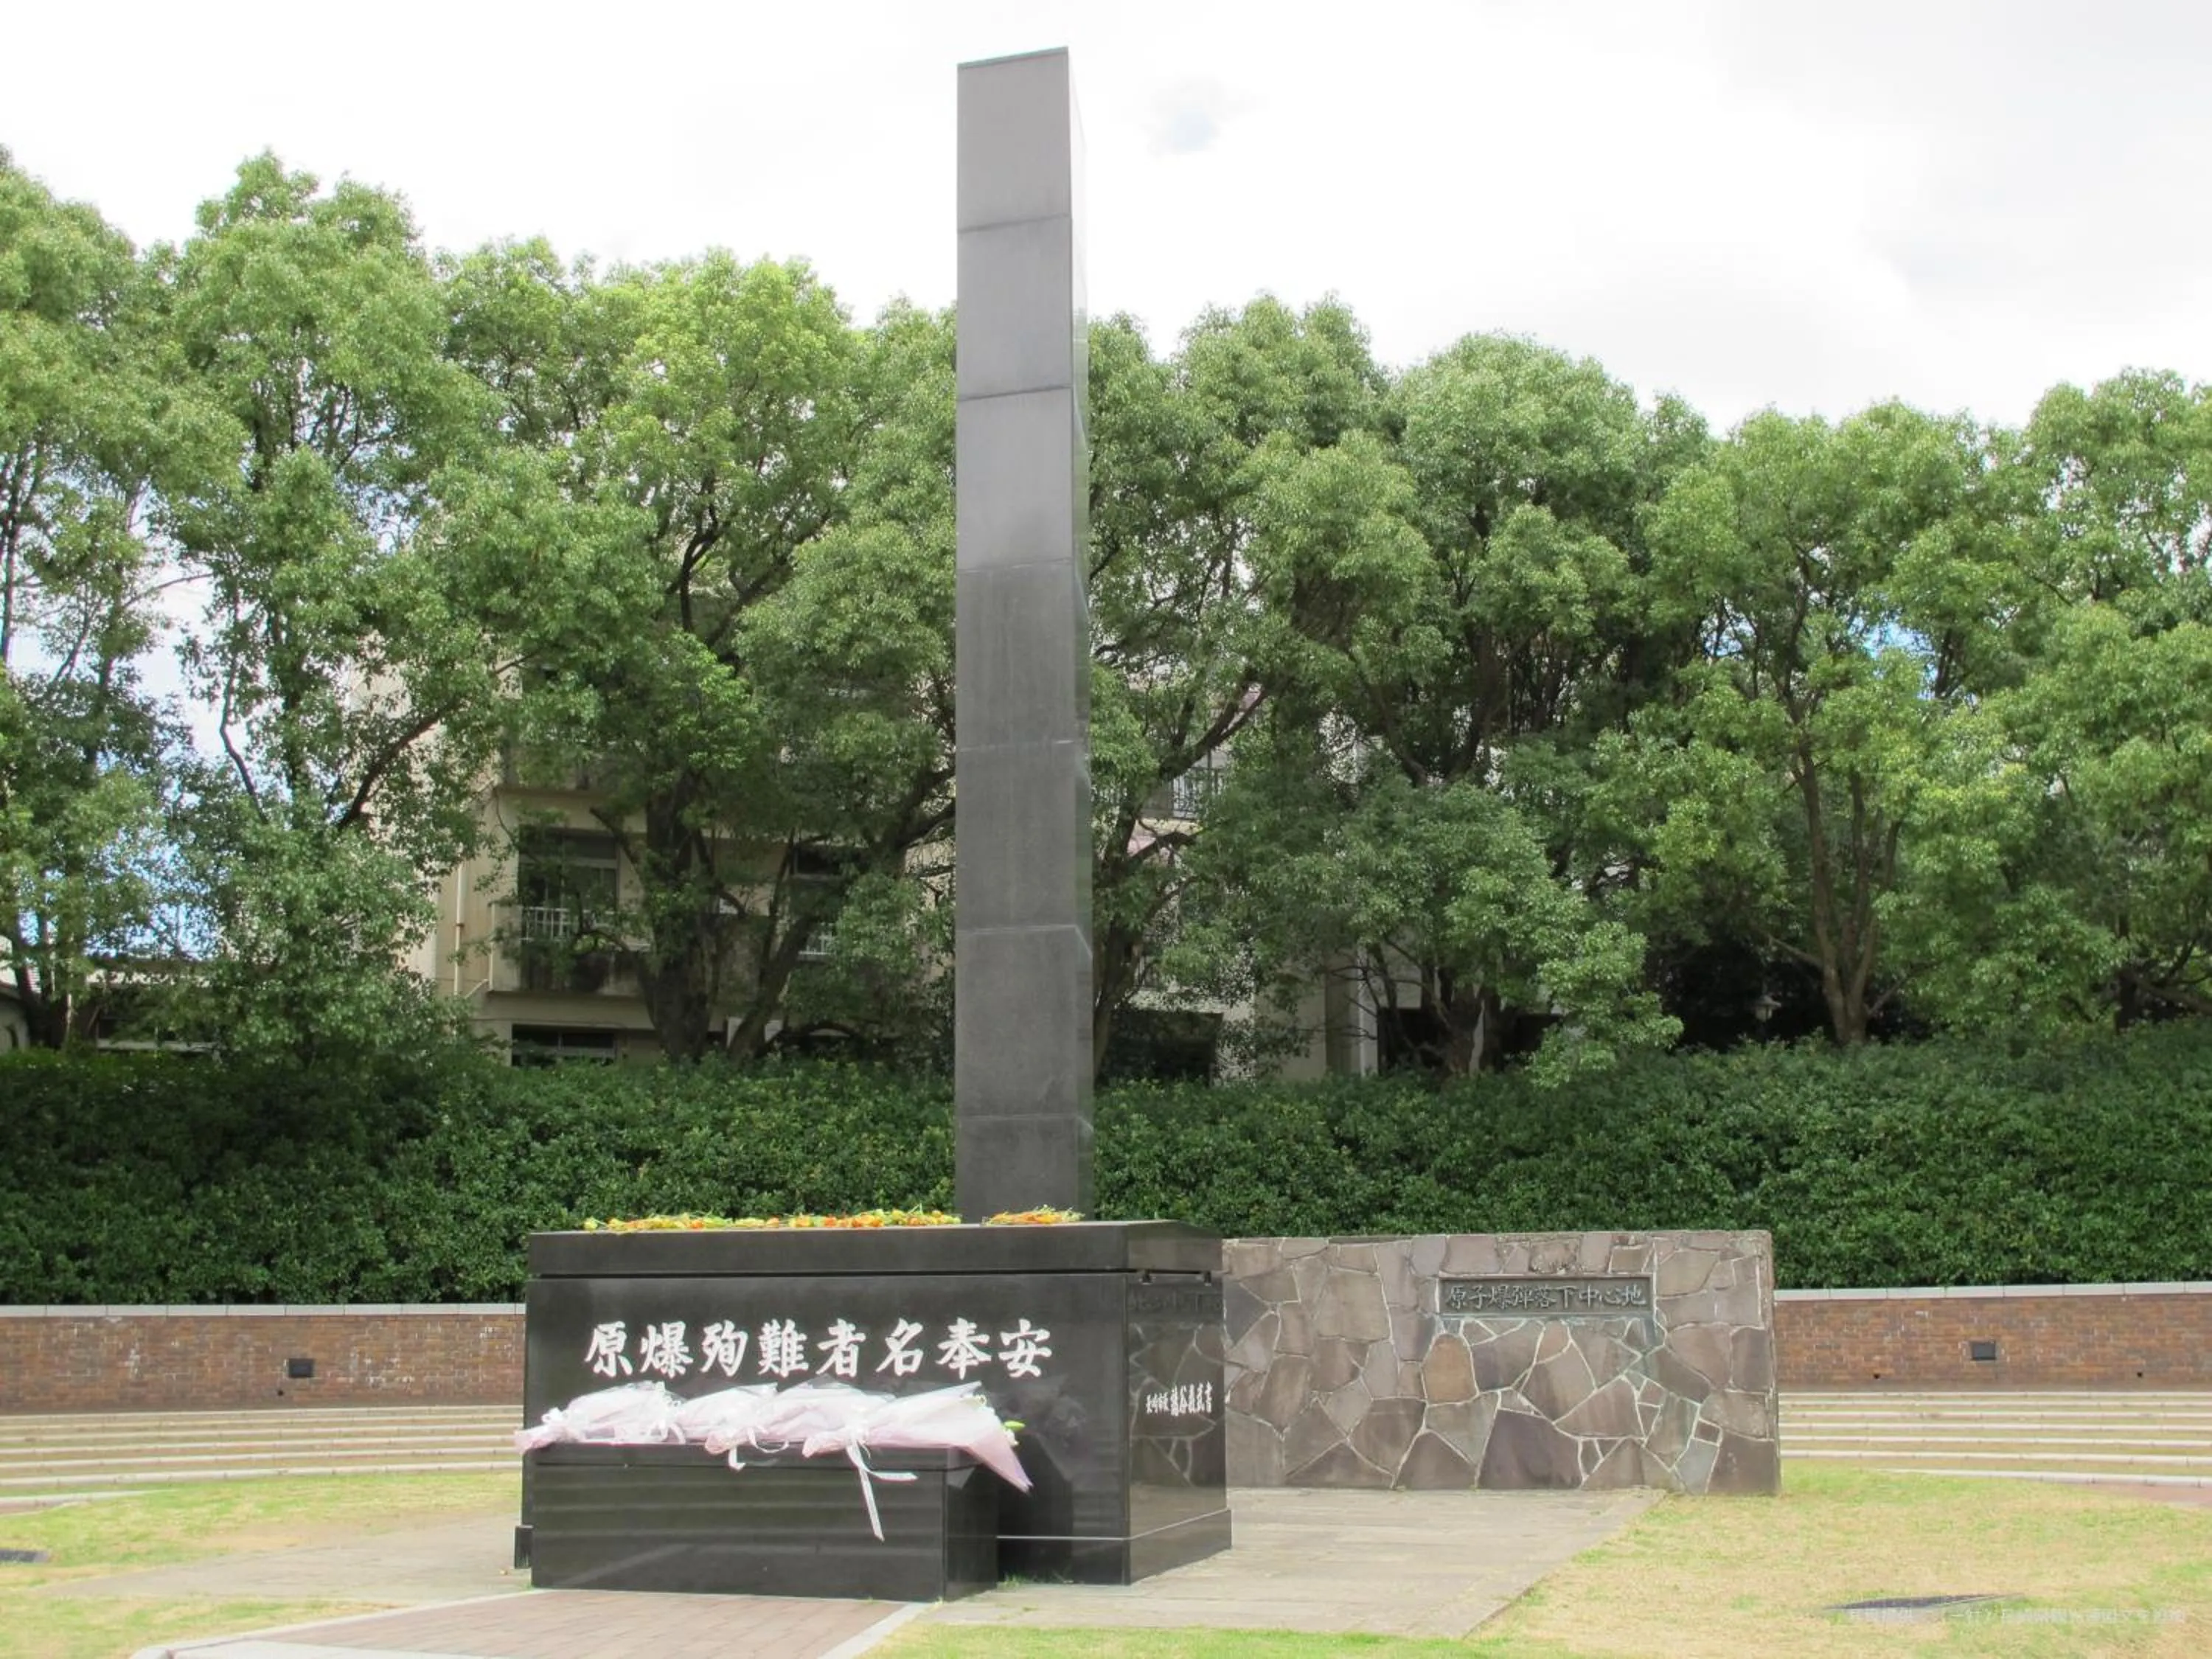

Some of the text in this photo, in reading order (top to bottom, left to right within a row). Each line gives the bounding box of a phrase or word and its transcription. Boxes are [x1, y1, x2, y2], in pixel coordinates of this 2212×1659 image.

[584, 1318, 1052, 1379] 原爆殉難者名奉安
